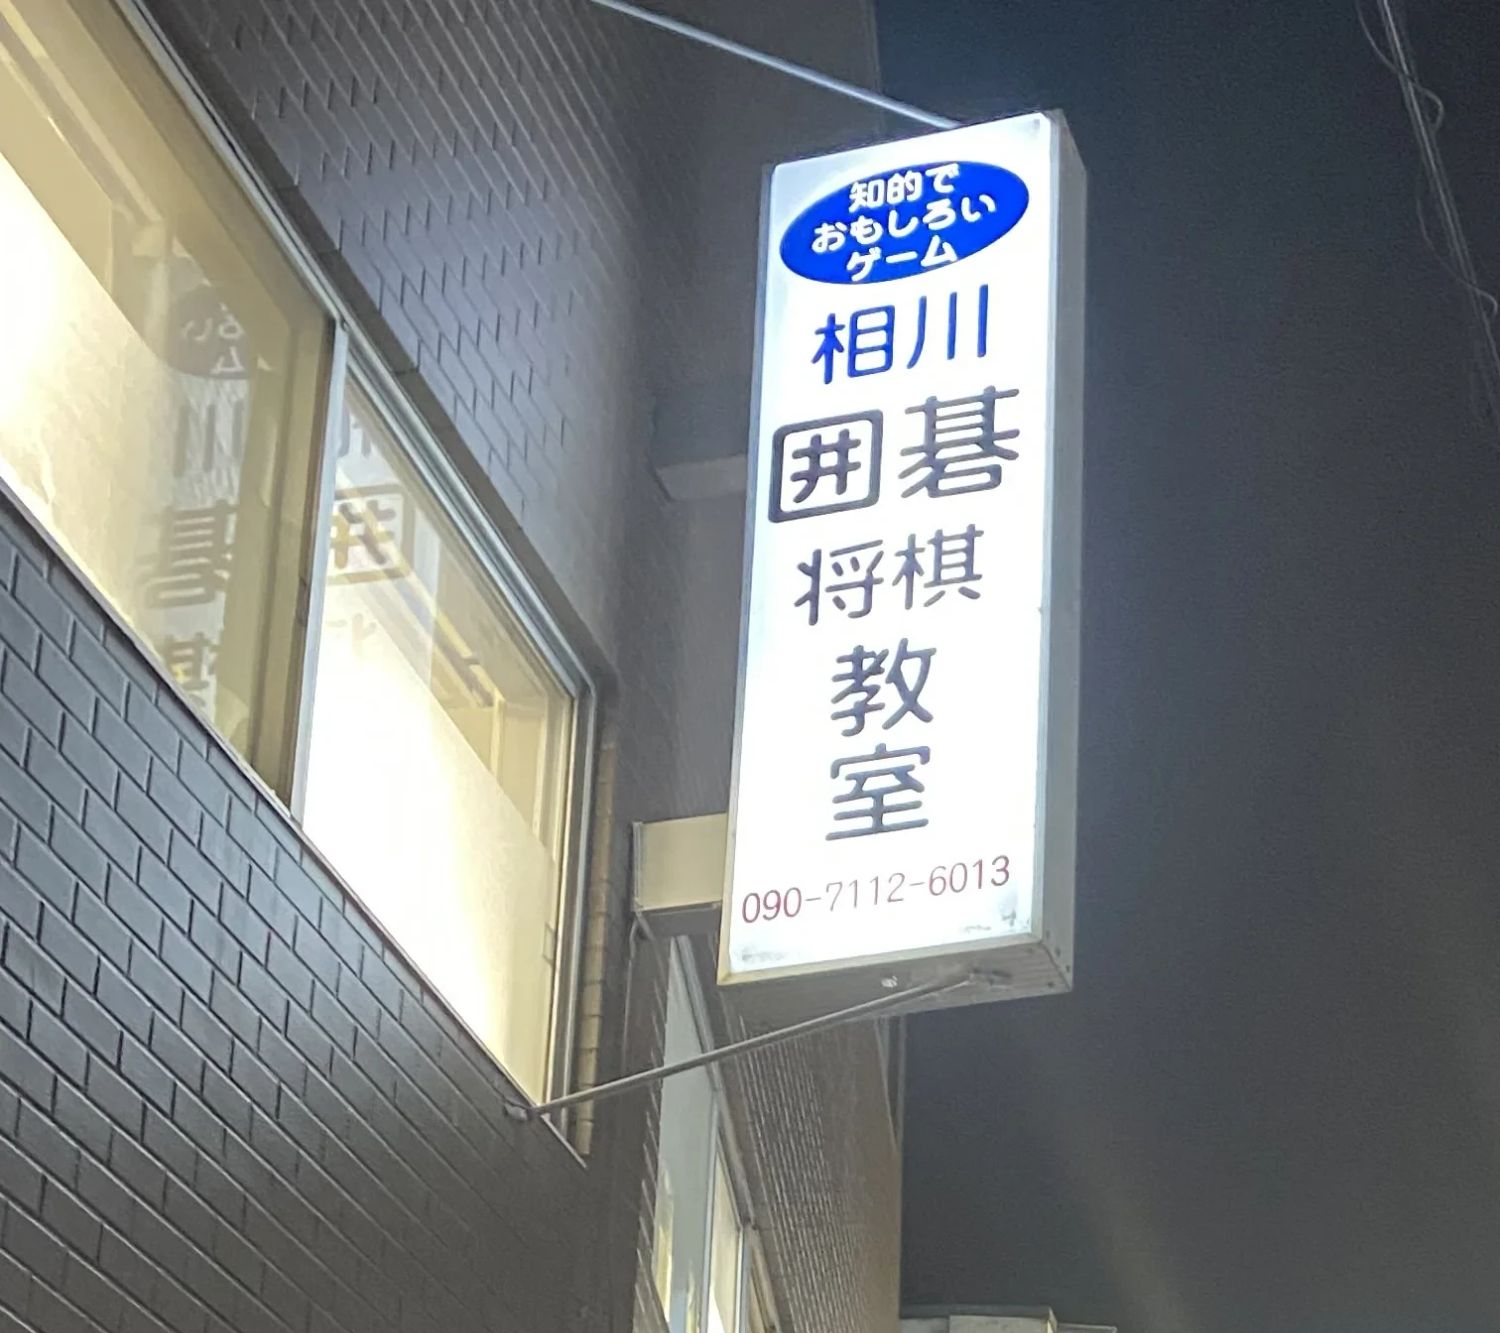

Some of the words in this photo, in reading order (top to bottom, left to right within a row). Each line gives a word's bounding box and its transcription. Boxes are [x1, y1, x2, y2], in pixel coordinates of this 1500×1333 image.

[811, 194, 996, 253] おもしろい
[849, 163, 959, 213] 知的で
[846, 235, 958, 282] ゲーム
[811, 284, 989, 384] 相川
[767, 385, 1021, 524] 囲碁
[793, 523, 984, 626] 将棋
[825, 638, 938, 841] 教室
[741, 855, 1011, 925] 090-7112-6013
